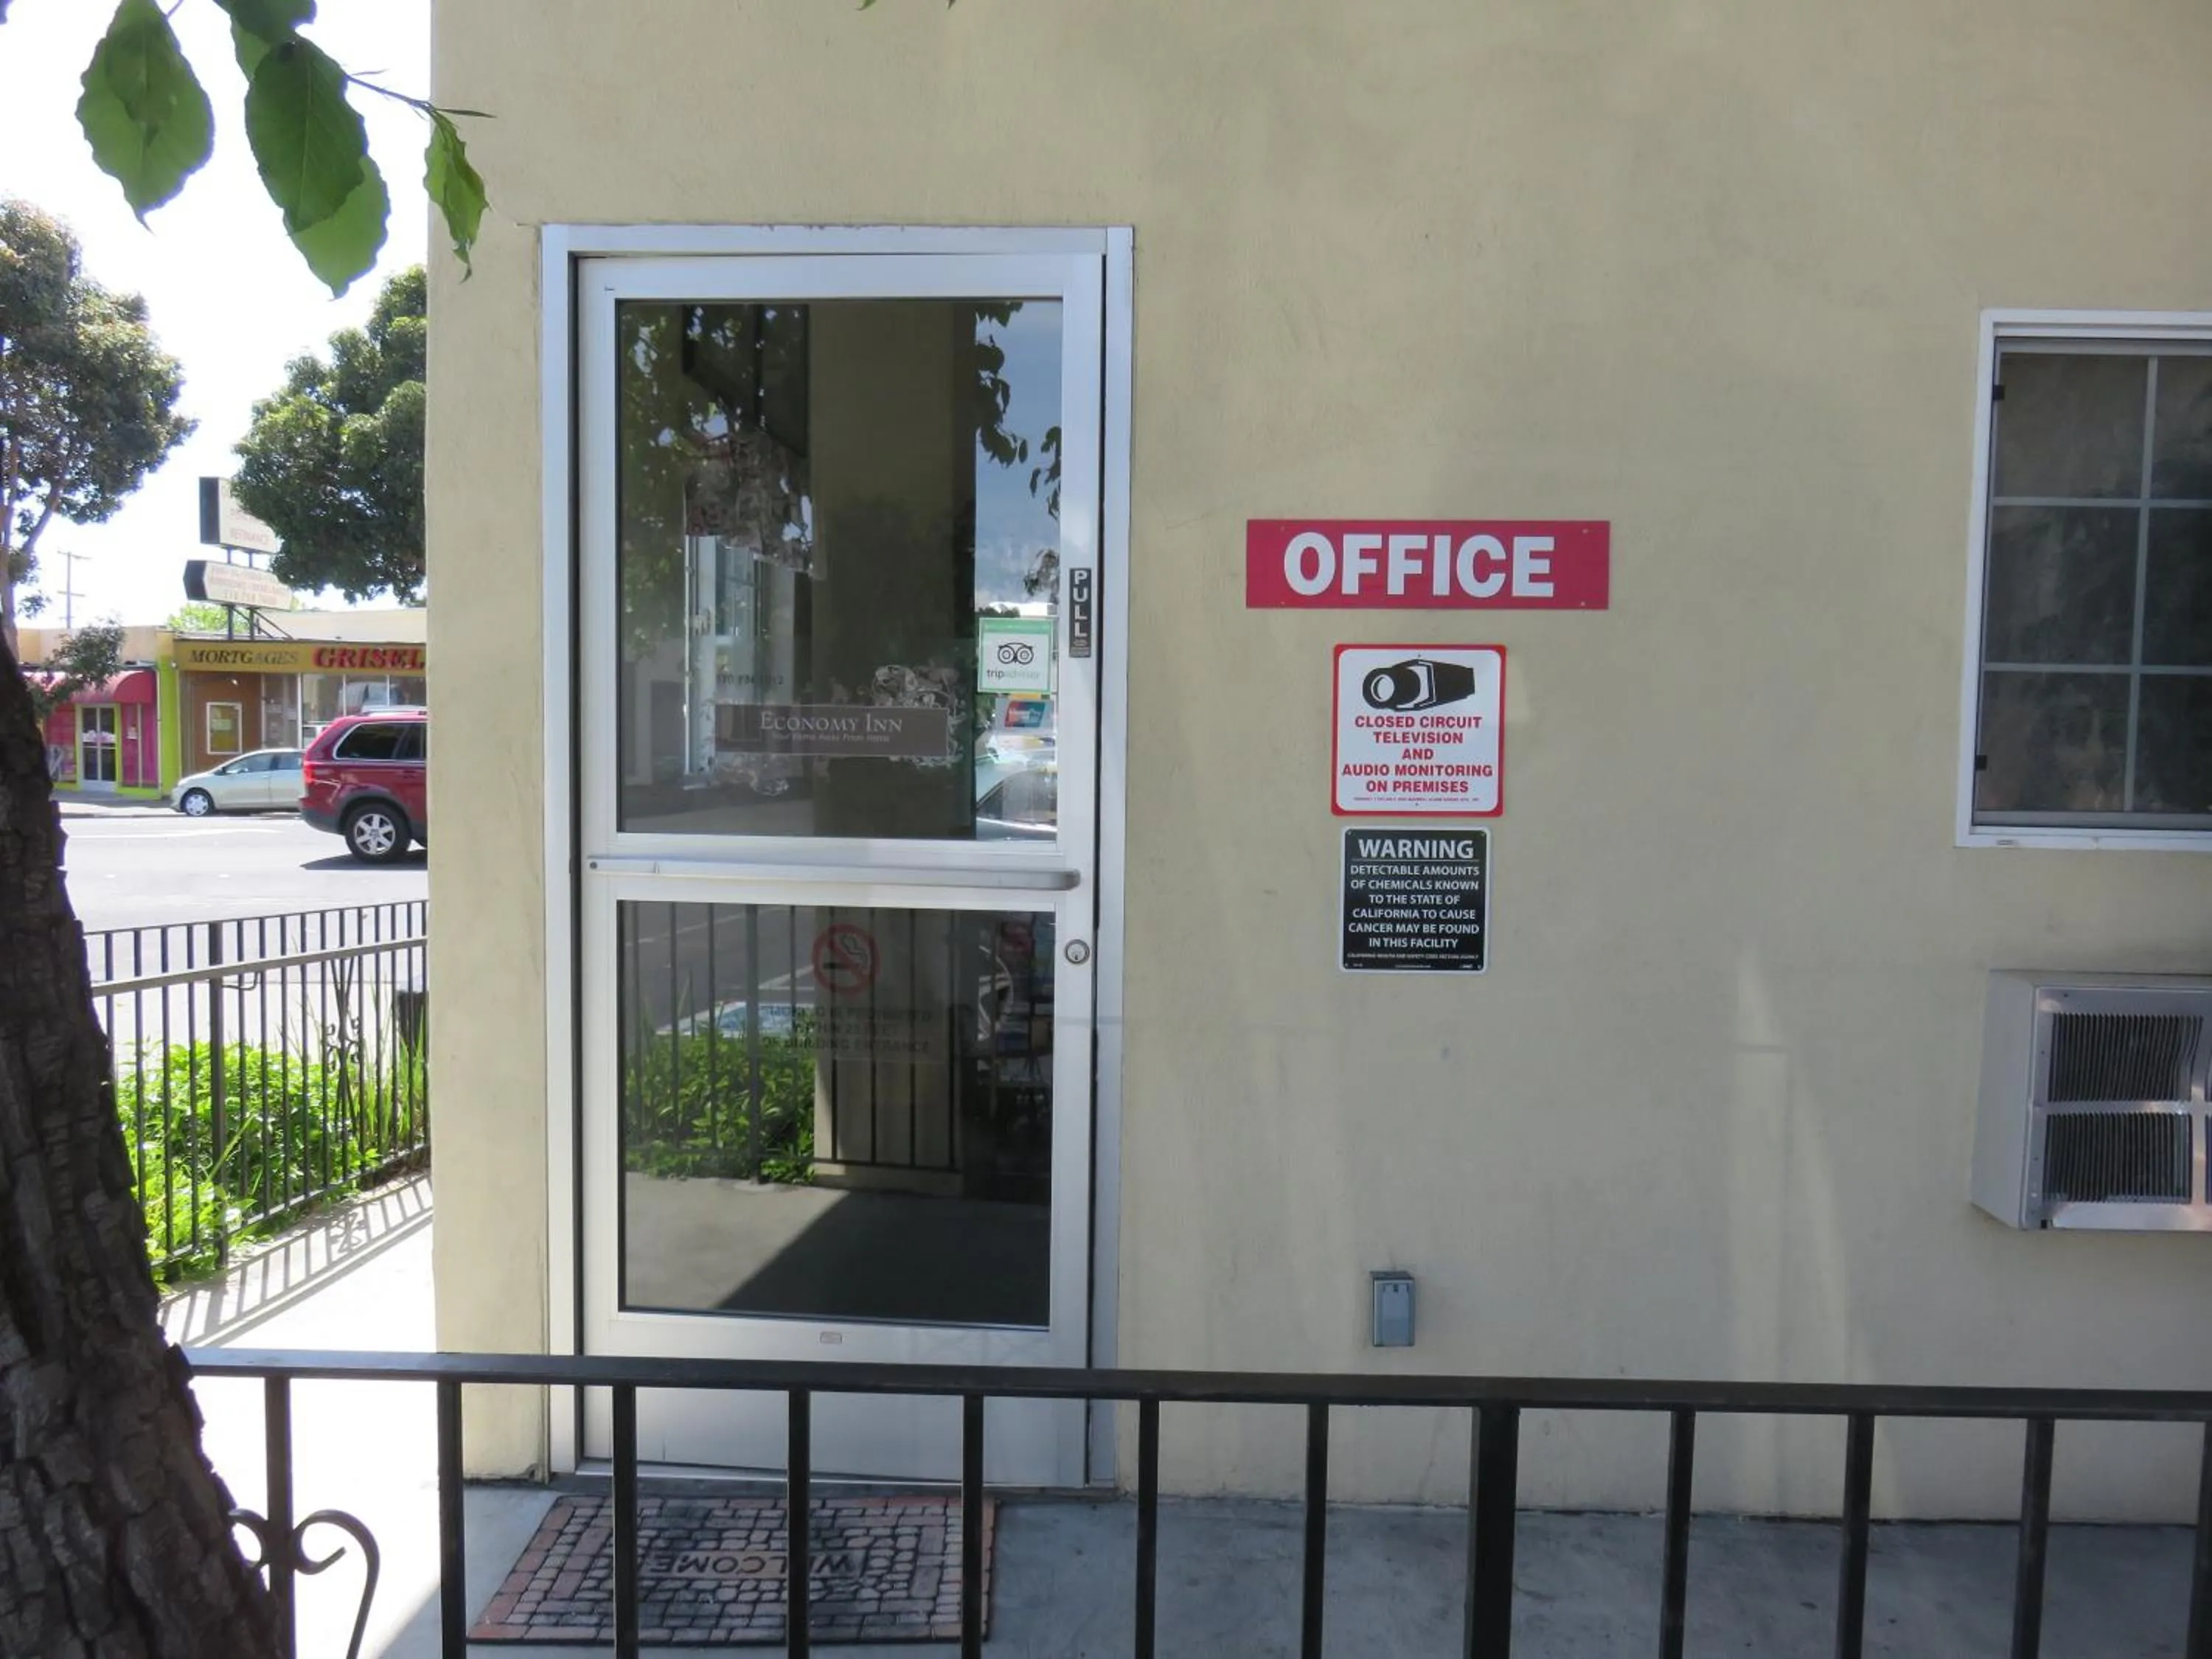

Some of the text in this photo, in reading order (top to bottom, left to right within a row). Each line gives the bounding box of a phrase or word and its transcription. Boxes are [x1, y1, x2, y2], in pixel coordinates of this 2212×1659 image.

[1284, 531, 1555, 598] OFFICE
[1073, 570, 1088, 639] PULL
[189, 649, 298, 664] MORTGAGES
[1354, 716, 1482, 728] CLOSED CIRCUIT
[1373, 731, 1464, 743] TELEVISION
[1402, 748, 1434, 760] AND
[1342, 764, 1493, 776] AUDIO MONITORING
[1366, 780, 1469, 793] ON PREMISES
[1358, 838, 1474, 859] WARNING
[1350, 865, 1480, 876] DETECTABLE AMOUNTS
[1350, 880, 1479, 890] OF CHEMICALS KNOWN
[1368, 894, 1461, 905] TO THE STATE OF
[1352, 908, 1475, 919] CALIFORNIA TO CAUSE
[1349, 923, 1480, 934] CANCER MAY BE FOUND
[1369, 938, 1458, 949] IN THIS FACILITY
[649, 1554, 854, 1574] WLCOME
